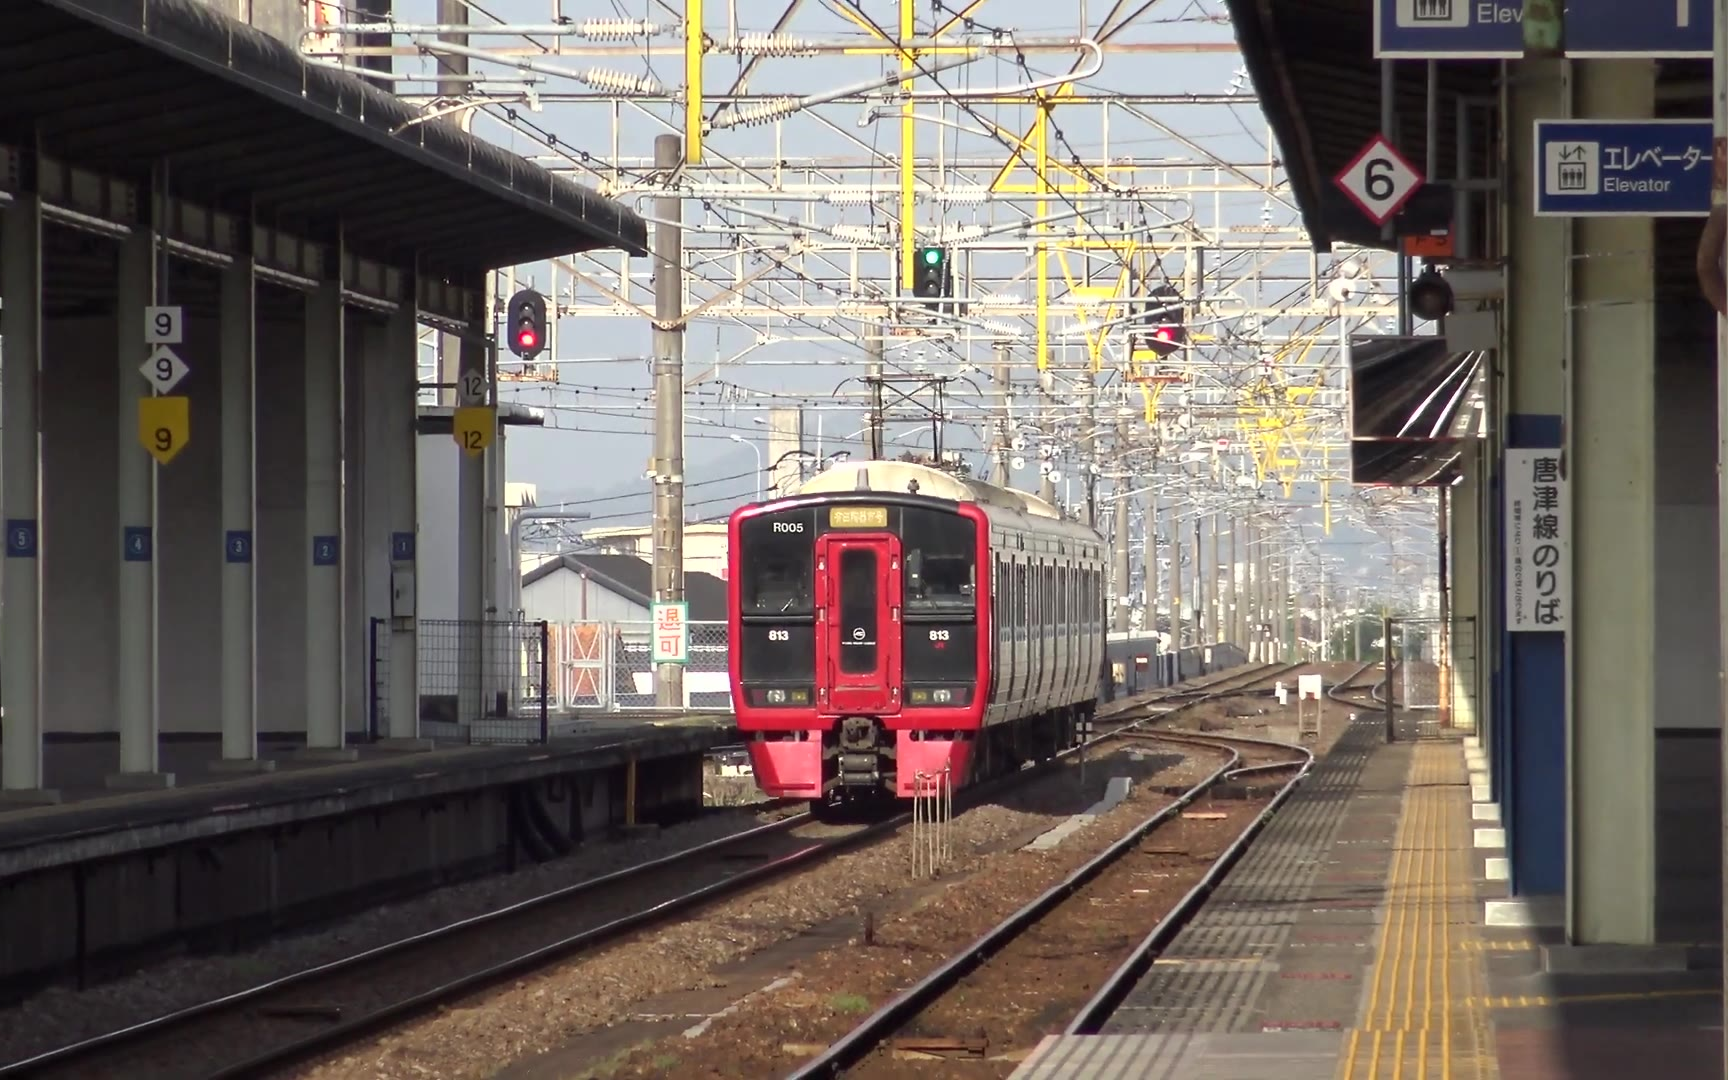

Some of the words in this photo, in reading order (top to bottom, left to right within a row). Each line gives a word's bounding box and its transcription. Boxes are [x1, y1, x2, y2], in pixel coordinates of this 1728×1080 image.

[1364, 158, 1395, 201] 6
[1603, 178, 1671, 192] Elevator
[155, 312, 172, 337] 9
[155, 357, 173, 382] 9
[464, 376, 482, 397] 12
[155, 427, 173, 452] 9
[463, 429, 484, 450] 12
[773, 522, 804, 533] R005
[1532, 456, 1561, 625] 唐津線のりば
[658, 607, 681, 657] 退可
[768, 629, 789, 641] 813
[929, 629, 950, 641] 813
